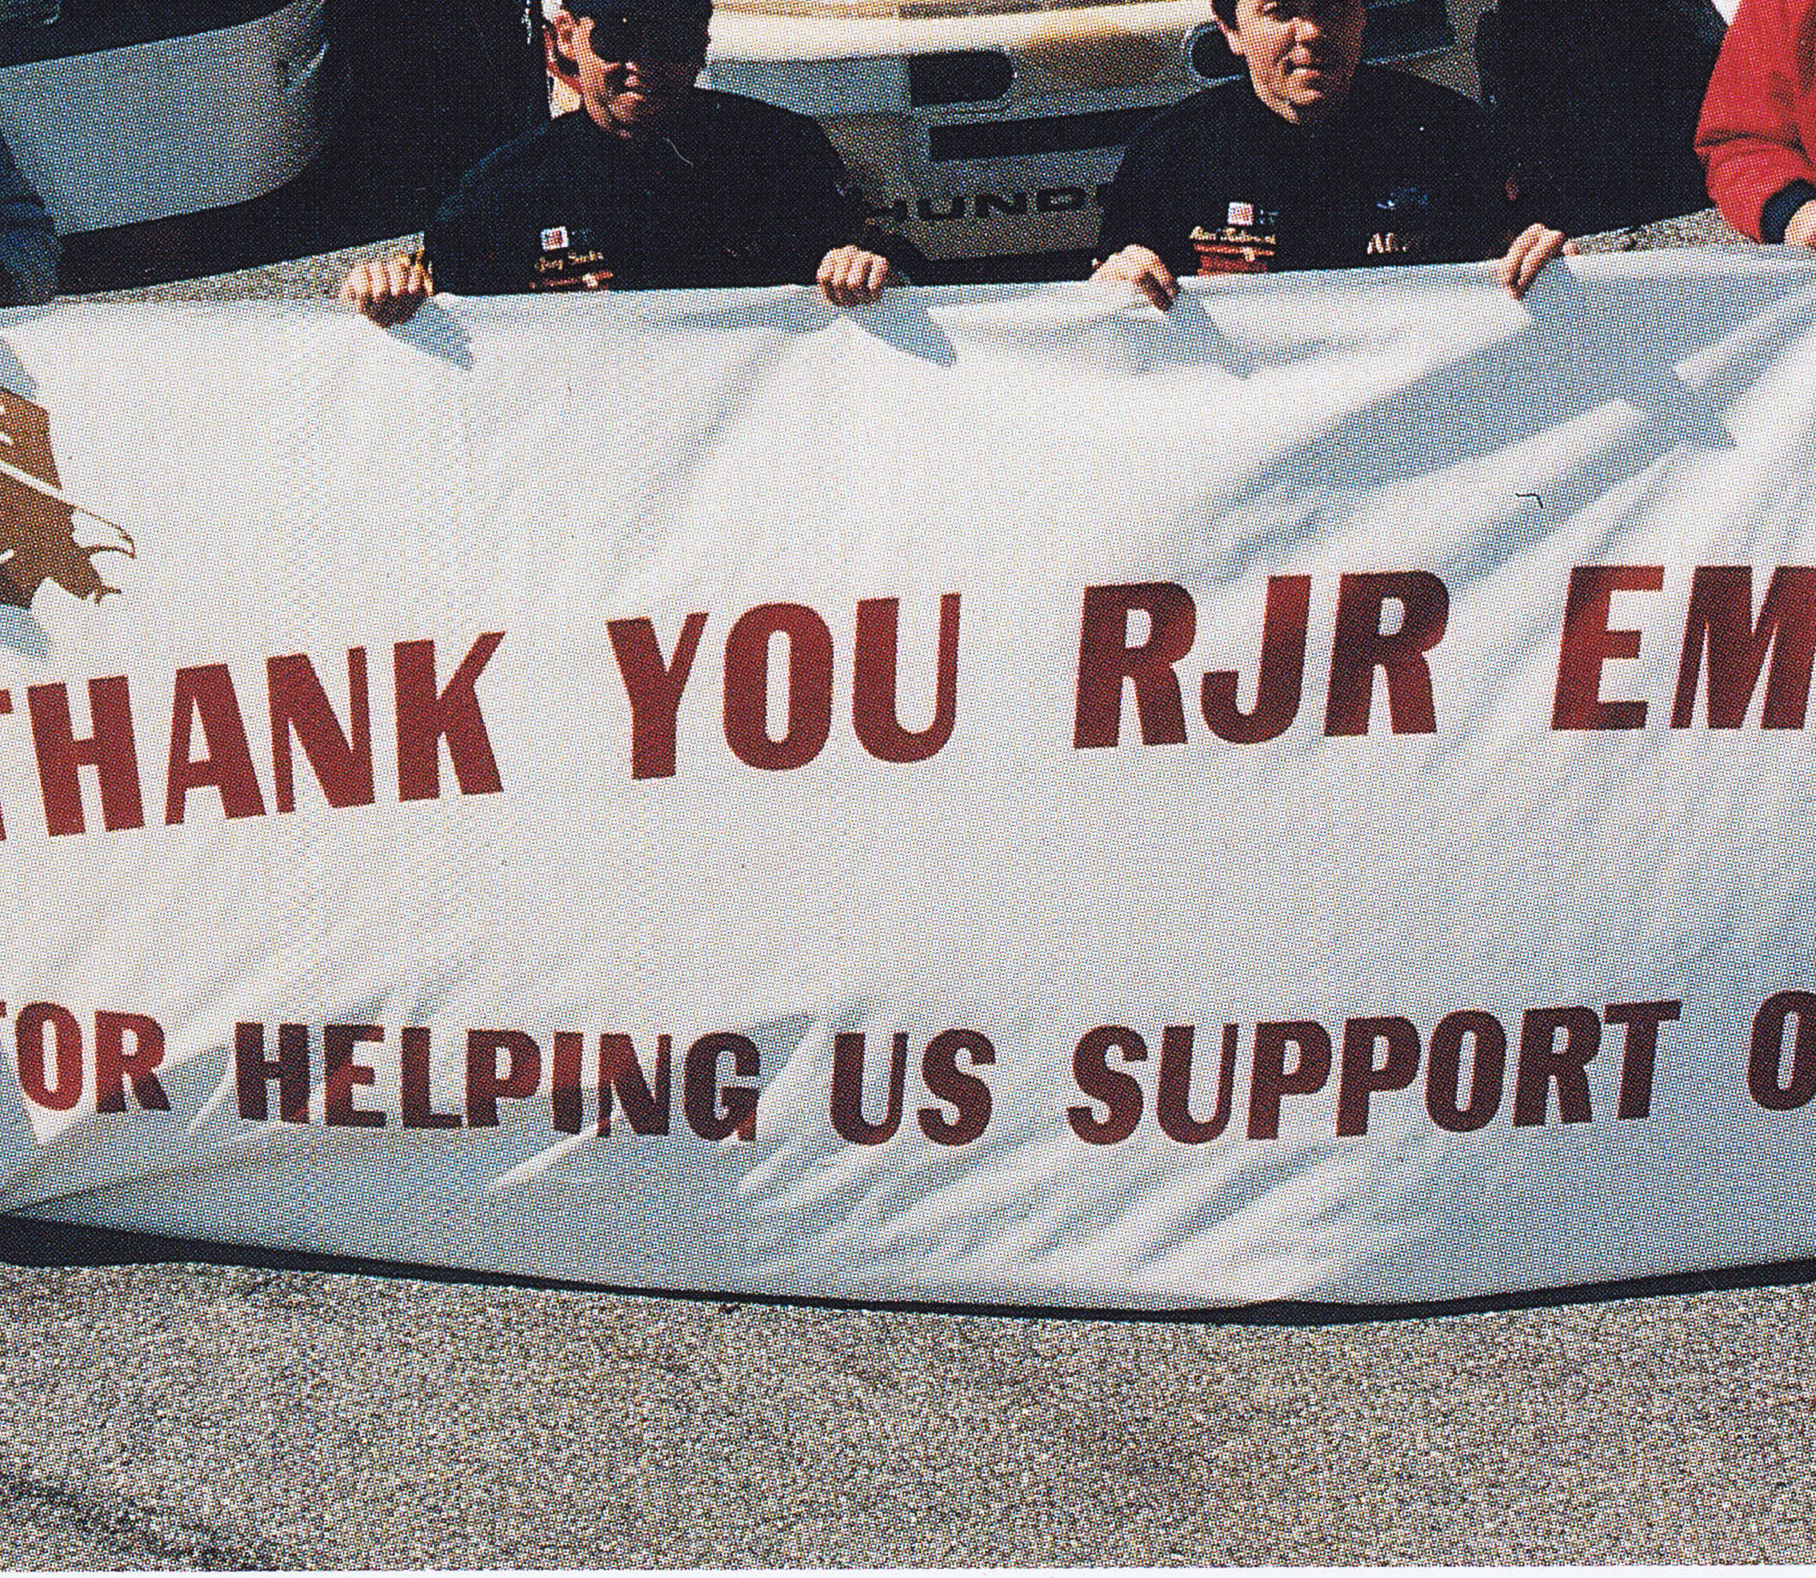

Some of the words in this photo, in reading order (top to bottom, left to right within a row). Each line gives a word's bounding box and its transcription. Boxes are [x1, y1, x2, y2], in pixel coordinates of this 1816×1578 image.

[604, 592, 962, 781] YOU
[1073, 572, 1451, 748] RJR
[234, 1022, 763, 1143] HELPING
[829, 1027, 994, 1147] US
[1065, 998, 1681, 1147] SUPPORT
